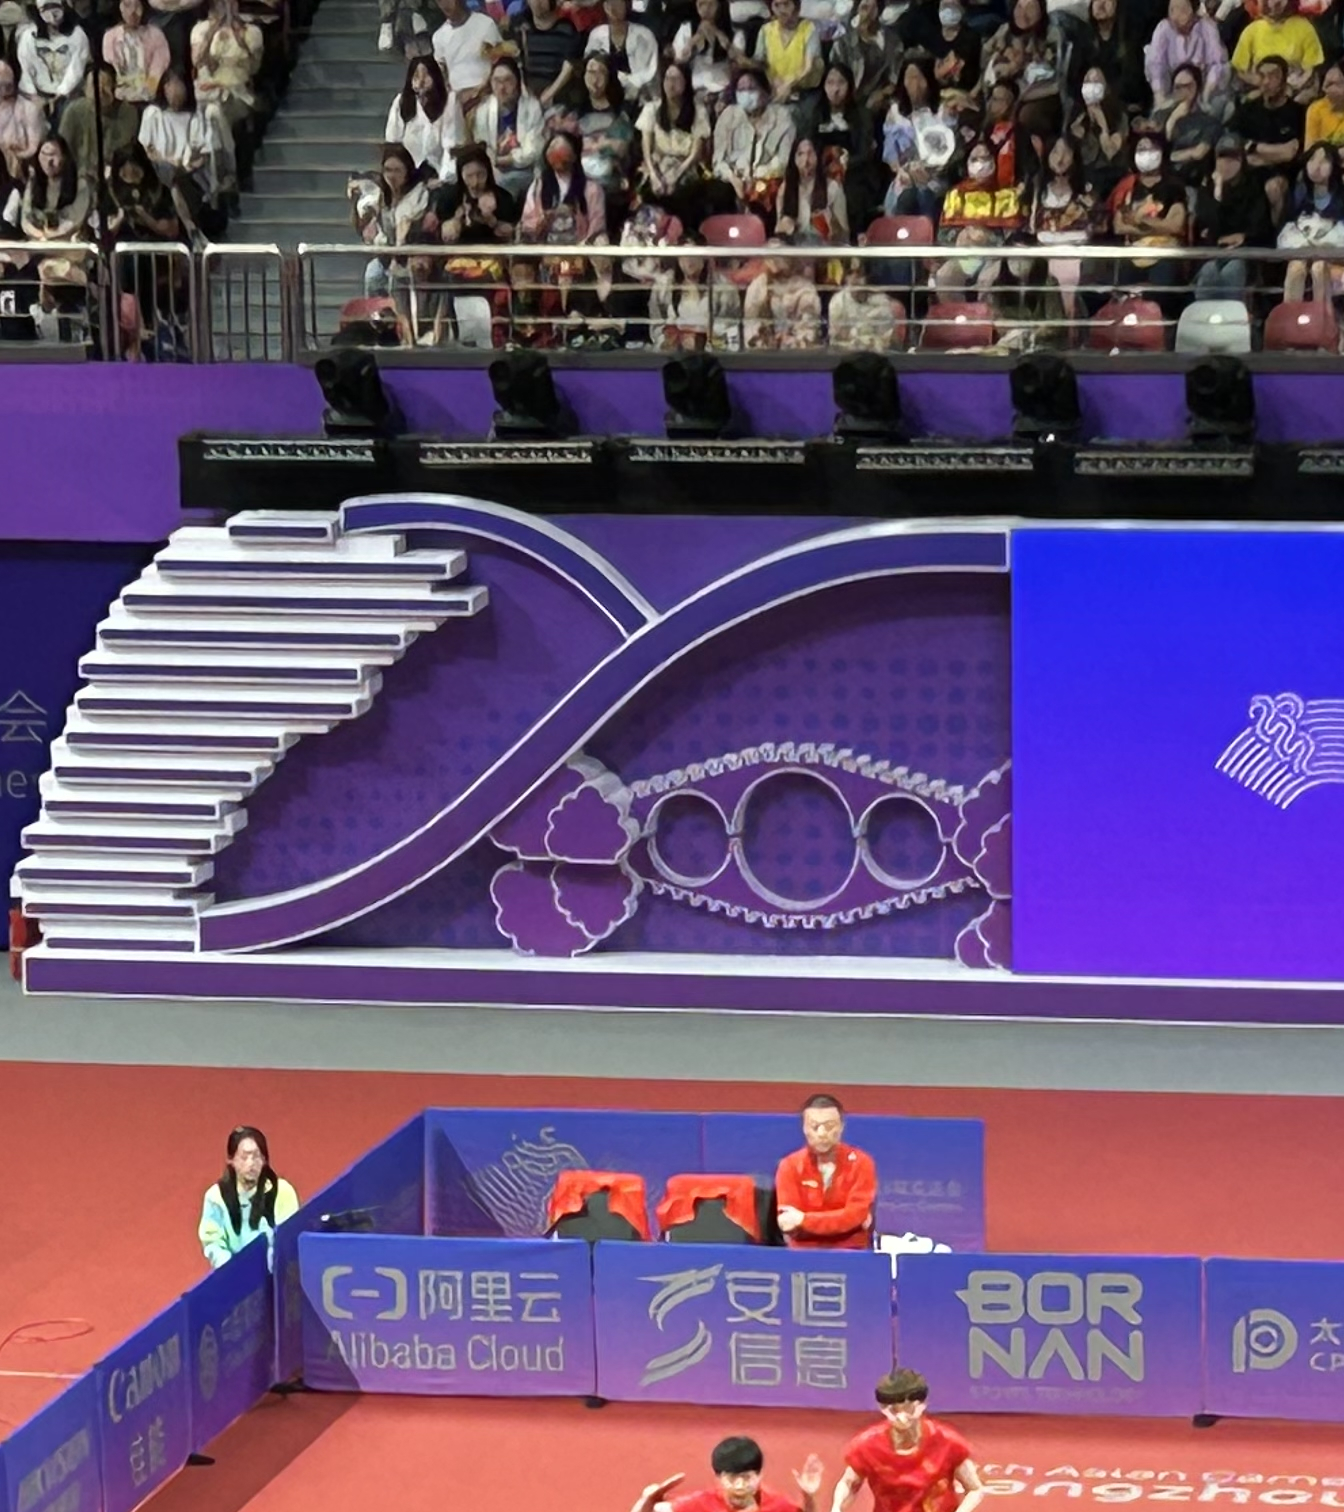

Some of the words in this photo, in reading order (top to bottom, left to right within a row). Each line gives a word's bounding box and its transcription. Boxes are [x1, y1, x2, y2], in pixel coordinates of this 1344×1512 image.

[418, 1269, 562, 1323] 阿里云
[724, 1270, 848, 1328] 安恒
[955, 1270, 1144, 1325] BOR
[108, 1333, 181, 1423] Canon
[327, 1330, 456, 1370] Alibaba
[468, 1333, 565, 1372] Cloud
[728, 1332, 849, 1389] 信息
